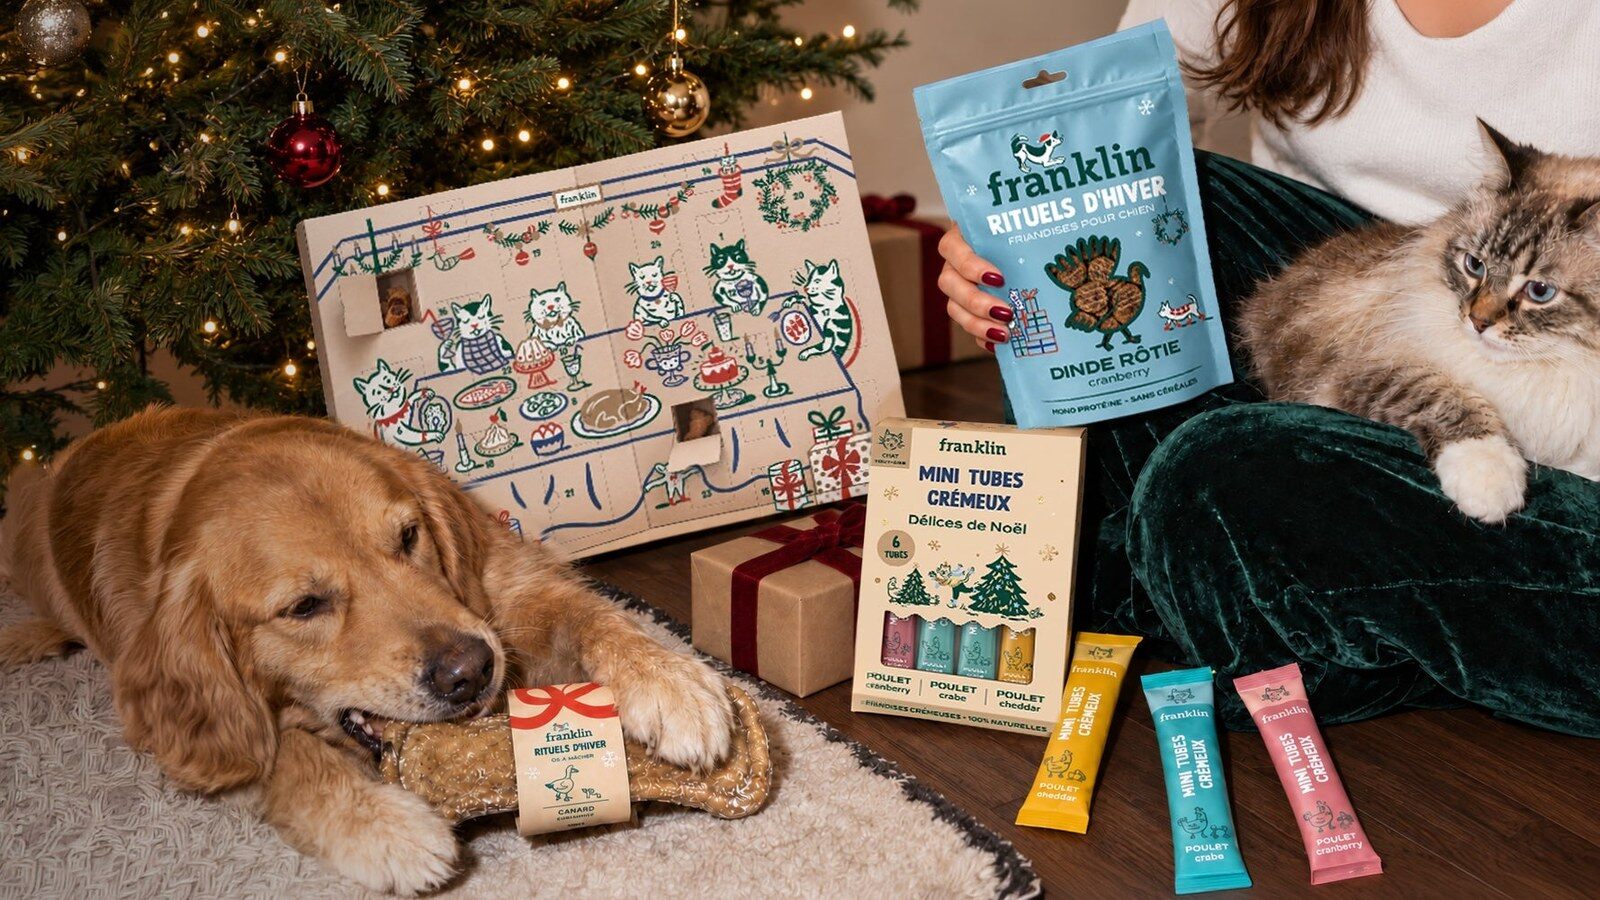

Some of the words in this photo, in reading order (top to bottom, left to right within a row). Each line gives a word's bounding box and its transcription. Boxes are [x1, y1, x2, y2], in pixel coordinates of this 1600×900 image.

[987, 142, 1156, 207] franklin
[559, 190, 598, 205] franklin
[792, 191, 805, 201] 20
[986, 197, 1076, 236] RITUELS
[1082, 175, 1168, 213] D'HIVER
[443, 221, 450, 230] 4
[1008, 221, 1079, 246] FRIANDISES
[1081, 213, 1116, 229] POUR
[1119, 204, 1155, 220] CHIEN
[718, 232, 724, 241] 1
[558, 347, 569, 357] 10
[758, 356, 765, 365] 5
[1050, 356, 1115, 380] DINDE
[1119, 339, 1182, 368] RÔTIE
[502, 365, 512, 375] 22
[1088, 367, 1151, 388] cranberry
[1052, 407, 1077, 416] MONO
[1077, 398, 1123, 414] PROTÉINE
[1130, 392, 1156, 403] SANS
[1156, 377, 1199, 397] CÉRÉALES
[758, 419, 765, 428] 7
[396, 426, 403, 436] 6
[939, 438, 1007, 456] franklin
[919, 465, 960, 484] MINI
[968, 468, 1024, 489] TUBES
[564, 488, 575, 498] 21
[927, 488, 1011, 512] CRÉMEUX
[908, 514, 963, 529] Délices
[967, 520, 987, 531] de
[990, 521, 1027, 535] Noël
[892, 535, 901, 548] 6
[884, 550, 909, 559] TUBES
[866, 672, 912, 685] POULET
[1072, 665, 1117, 678] franklin
[865, 682, 911, 695] cranberry
[930, 680, 978, 694] POULET
[938, 690, 967, 702] crabe
[996, 690, 1045, 704] POULET
[1066, 686, 1086, 713] TUBES
[999, 700, 1041, 713] cheddar
[910, 706, 962, 720] CRÉMEUSES
[968, 715, 989, 724] 100%
[991, 719, 1048, 733] NATURELLES
[1160, 708, 1210, 723] franklin
[1261, 705, 1309, 724] franklin
[545, 728, 593, 743] franklin
[534, 744, 570, 757] RITUELS
[573, 739, 607, 752] D'HIVER
[1171, 734, 1191, 769] TUBES
[1279, 732, 1303, 767] TUBES
[1039, 781, 1080, 794] POULET
[1178, 769, 1196, 799] MINI
[1293, 767, 1316, 794] MINI
[557, 805, 595, 816] CANARD
[1316, 832, 1357, 846] POULET
[1185, 842, 1229, 854] POULET
[1316, 841, 1363, 856] cranberry
